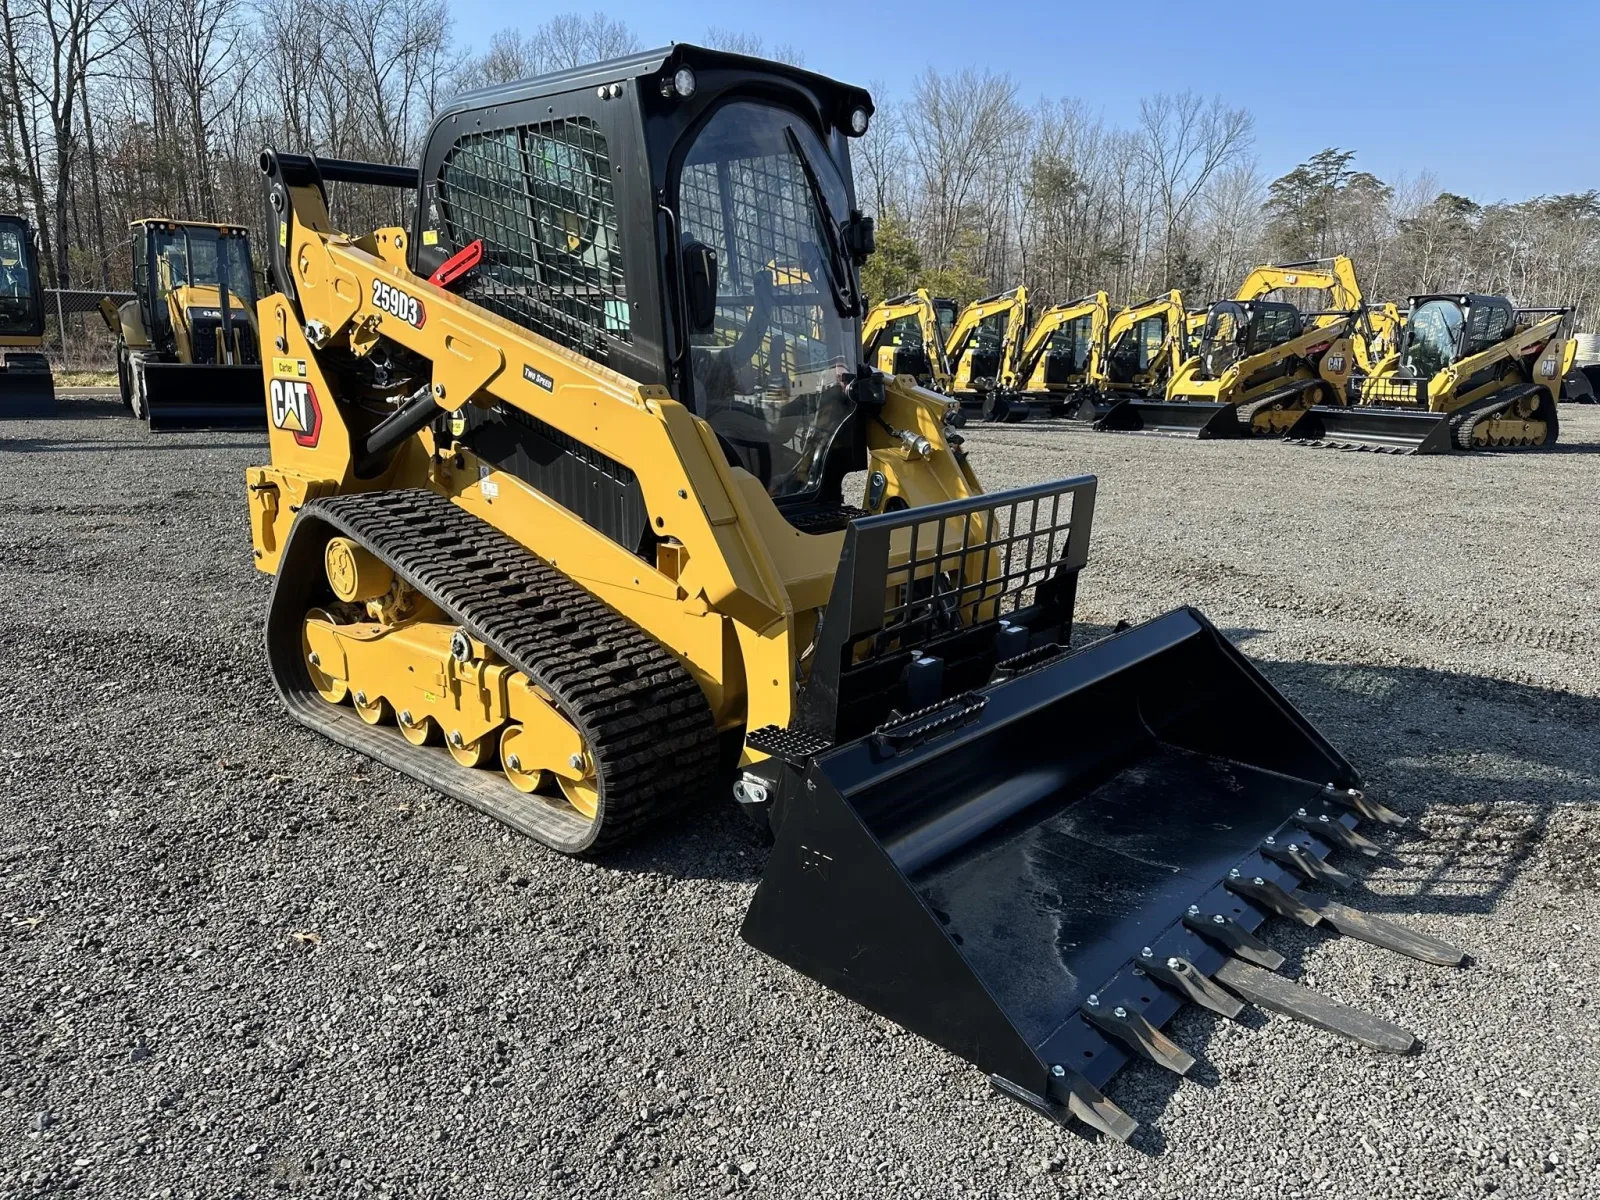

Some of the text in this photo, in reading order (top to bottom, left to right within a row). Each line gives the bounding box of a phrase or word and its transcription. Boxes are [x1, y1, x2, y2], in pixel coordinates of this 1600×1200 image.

[1285, 275, 1297, 283] CAT
[372, 278, 418, 325] 259D3
[279, 362, 293, 373] Carter
[1328, 357, 1343, 370] CAT
[1541, 360, 1556, 376] CAT
[271, 379, 308, 432] CAT
